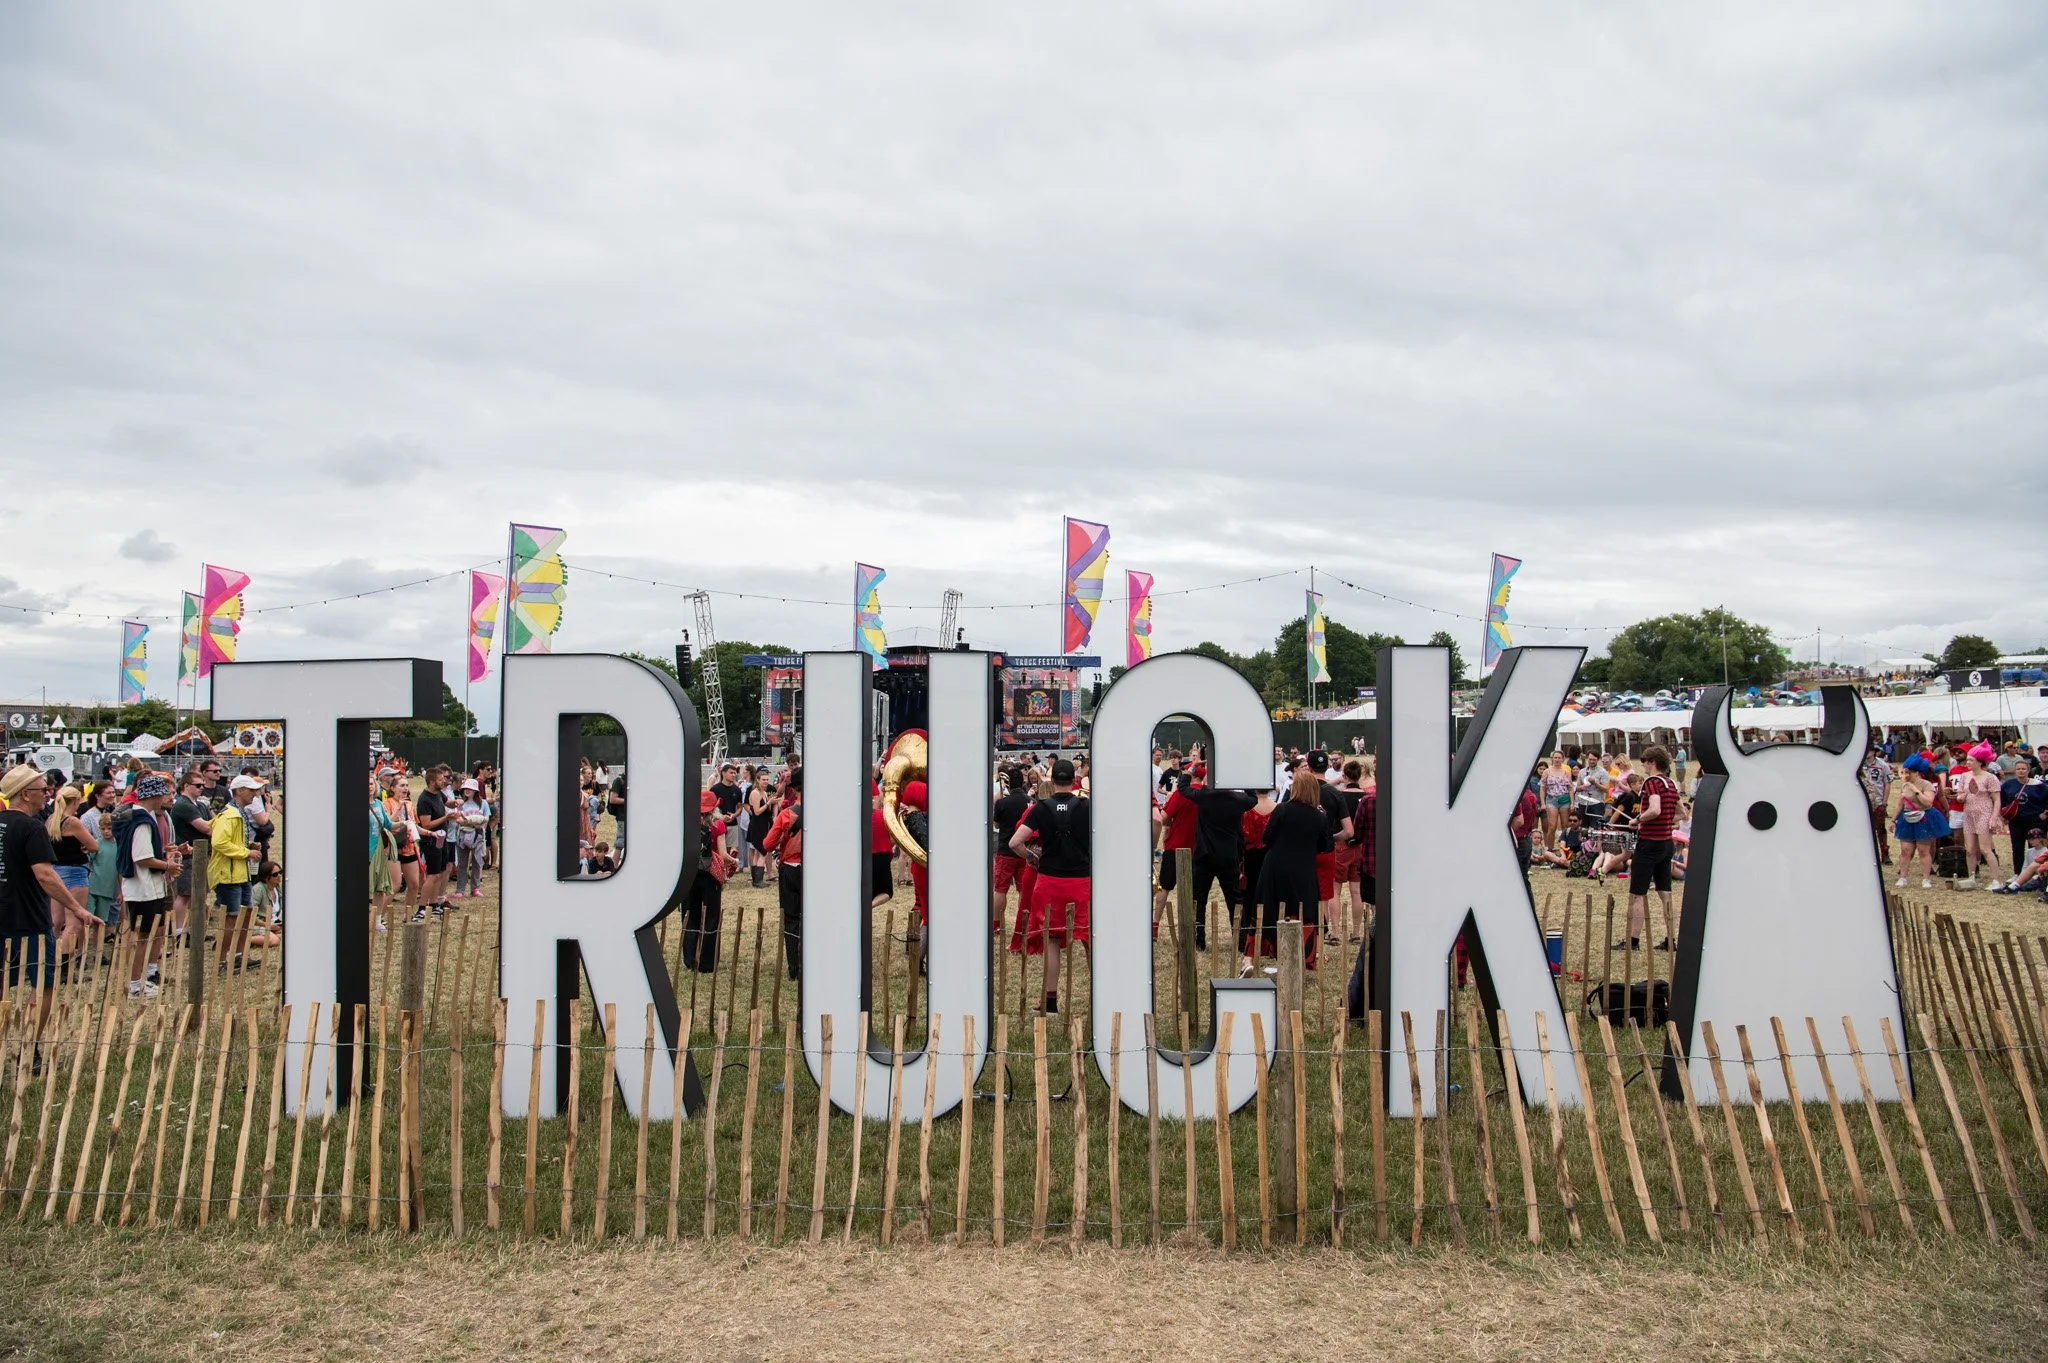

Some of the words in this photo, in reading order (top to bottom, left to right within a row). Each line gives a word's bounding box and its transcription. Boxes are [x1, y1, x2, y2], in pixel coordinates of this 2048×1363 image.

[774, 657, 795, 665] TRUCK
[902, 656, 927, 665] TRUC
[1015, 658, 1038, 666] TRUCK
[1038, 658, 1069, 666] FESTIVAL
[210, 646, 1587, 1121] TRUCK
